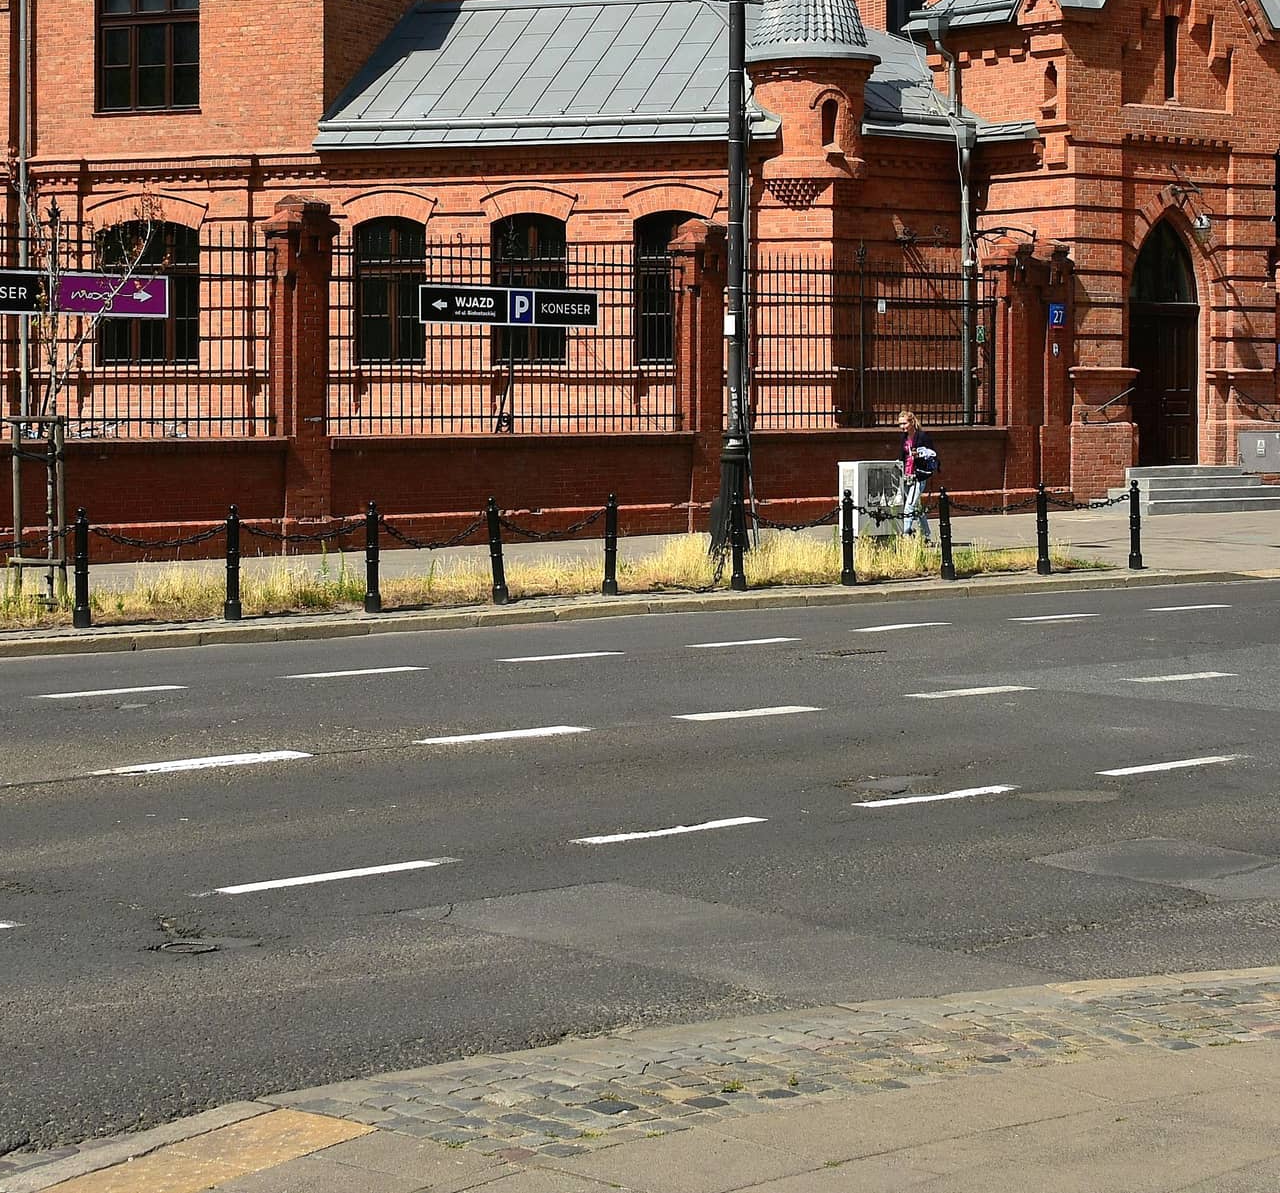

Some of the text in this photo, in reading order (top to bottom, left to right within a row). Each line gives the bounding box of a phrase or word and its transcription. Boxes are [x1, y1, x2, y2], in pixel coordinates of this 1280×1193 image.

[454, 296, 495, 309] WJAZD
[515, 295, 530, 319] P
[540, 302, 591, 316] KONESER
[1053, 310, 1064, 324] 27
